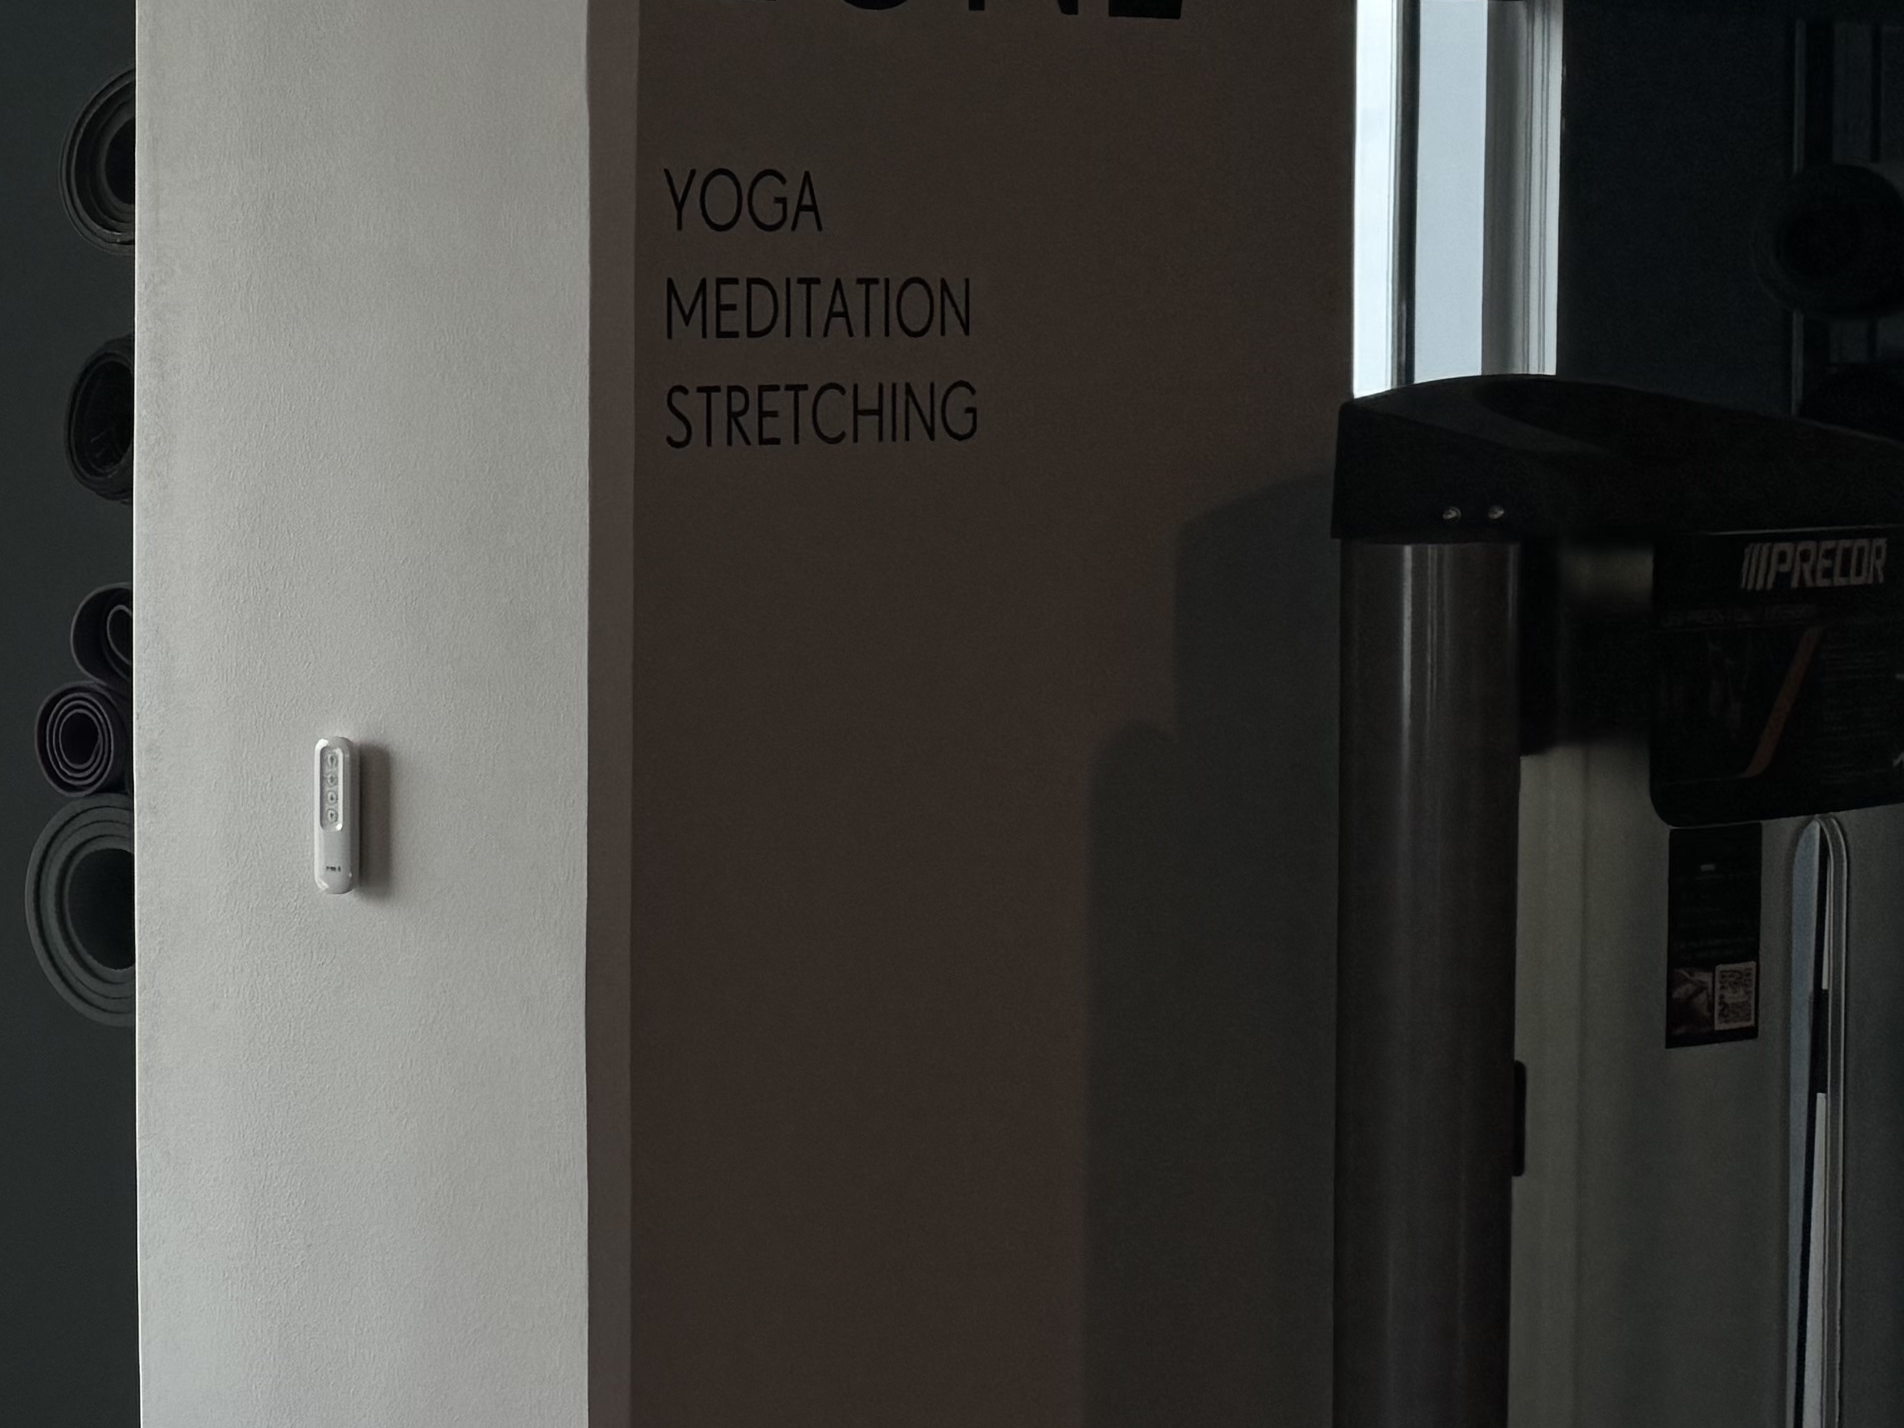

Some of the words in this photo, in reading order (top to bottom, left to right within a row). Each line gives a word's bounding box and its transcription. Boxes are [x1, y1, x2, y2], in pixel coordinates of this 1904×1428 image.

[664, 168, 822, 232] YOGA
[667, 277, 969, 339] MEDITATION
[666, 380, 977, 448] STRETCHING
[1766, 537, 1887, 590] PRECOR
